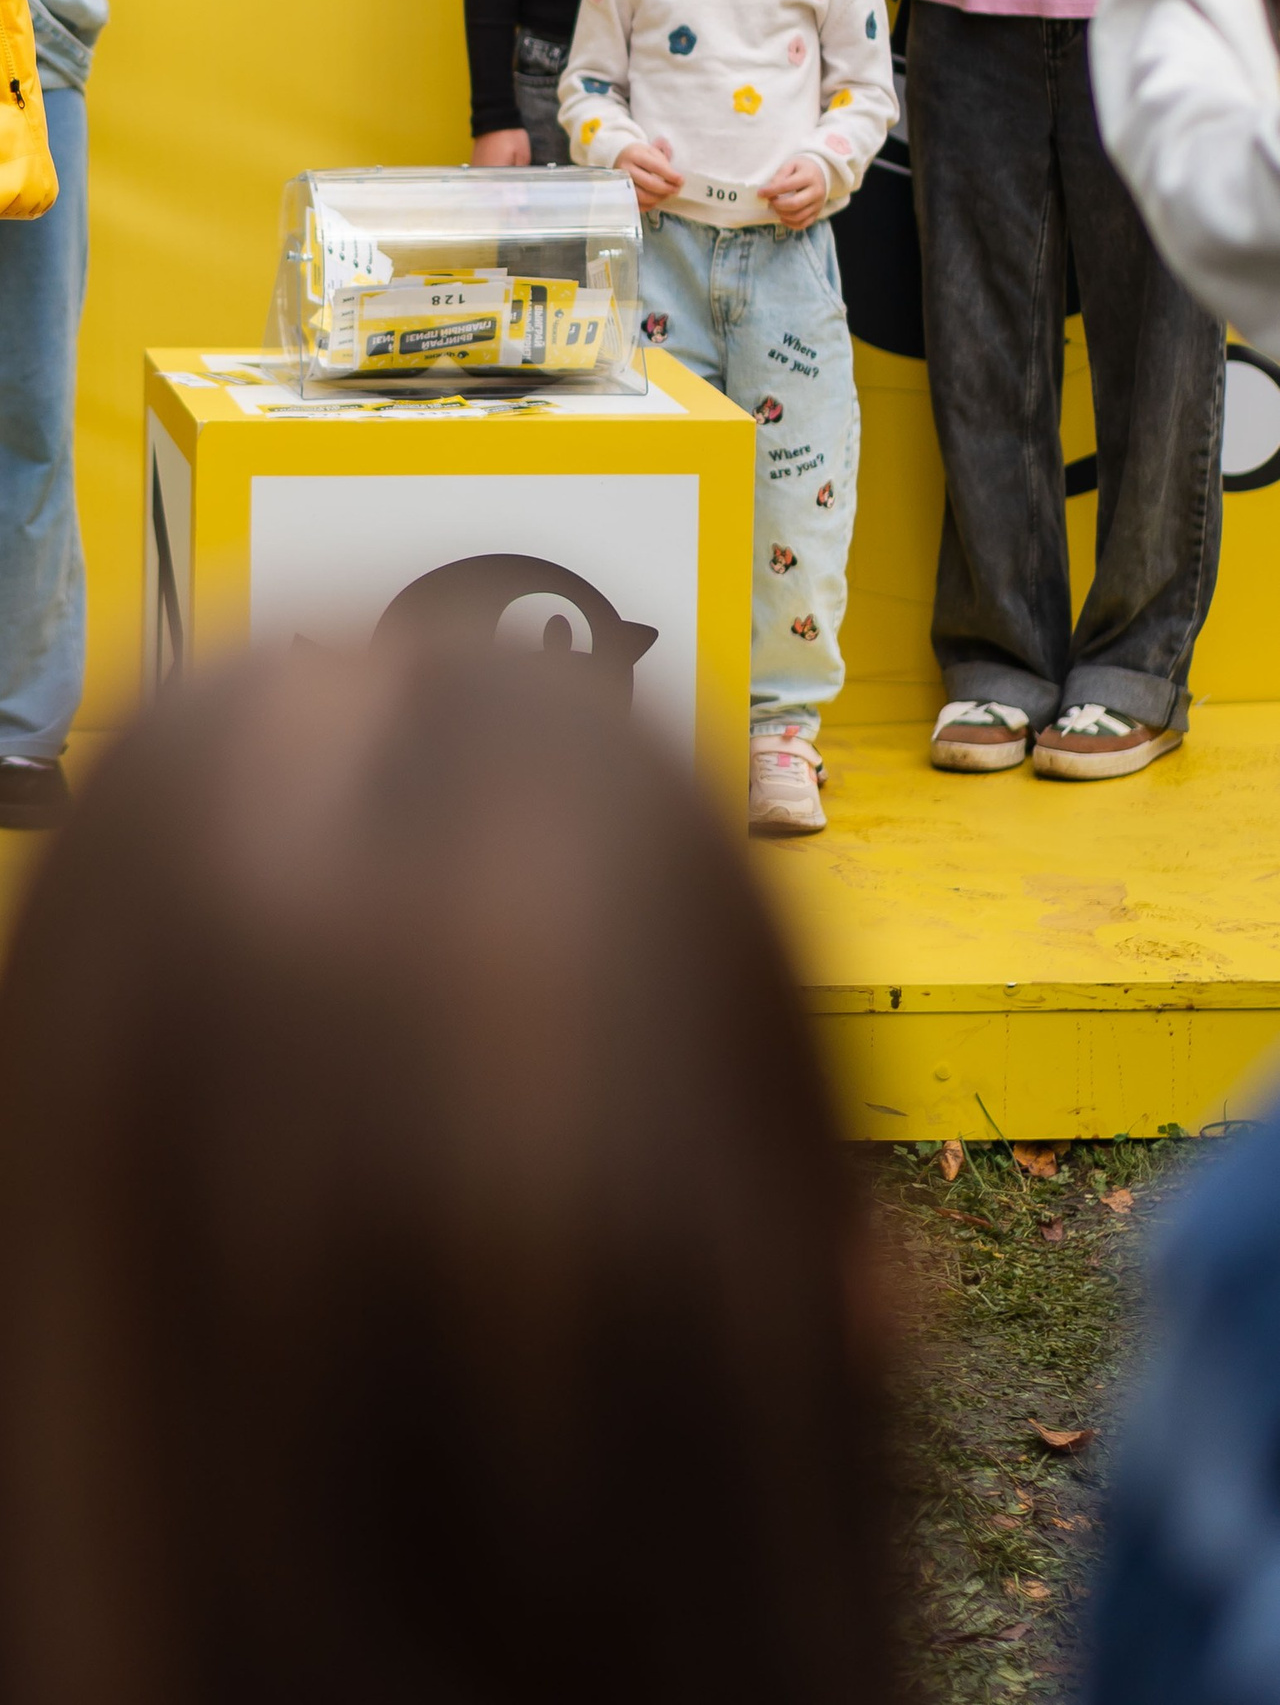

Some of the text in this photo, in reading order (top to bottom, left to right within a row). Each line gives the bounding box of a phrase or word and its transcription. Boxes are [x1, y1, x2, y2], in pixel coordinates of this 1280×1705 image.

[705, 185, 739, 204] 300
[431, 293, 466, 306] 128
[405, 320, 492, 343] ГЛАВНЫЙ ПРИЗ!
[421, 332, 474, 351] ВЫИГРАЙ
[781, 331, 819, 361] Where
[767, 348, 820, 380] are you?
[768, 442, 812, 463] Where
[769, 452, 826, 481] are you?
